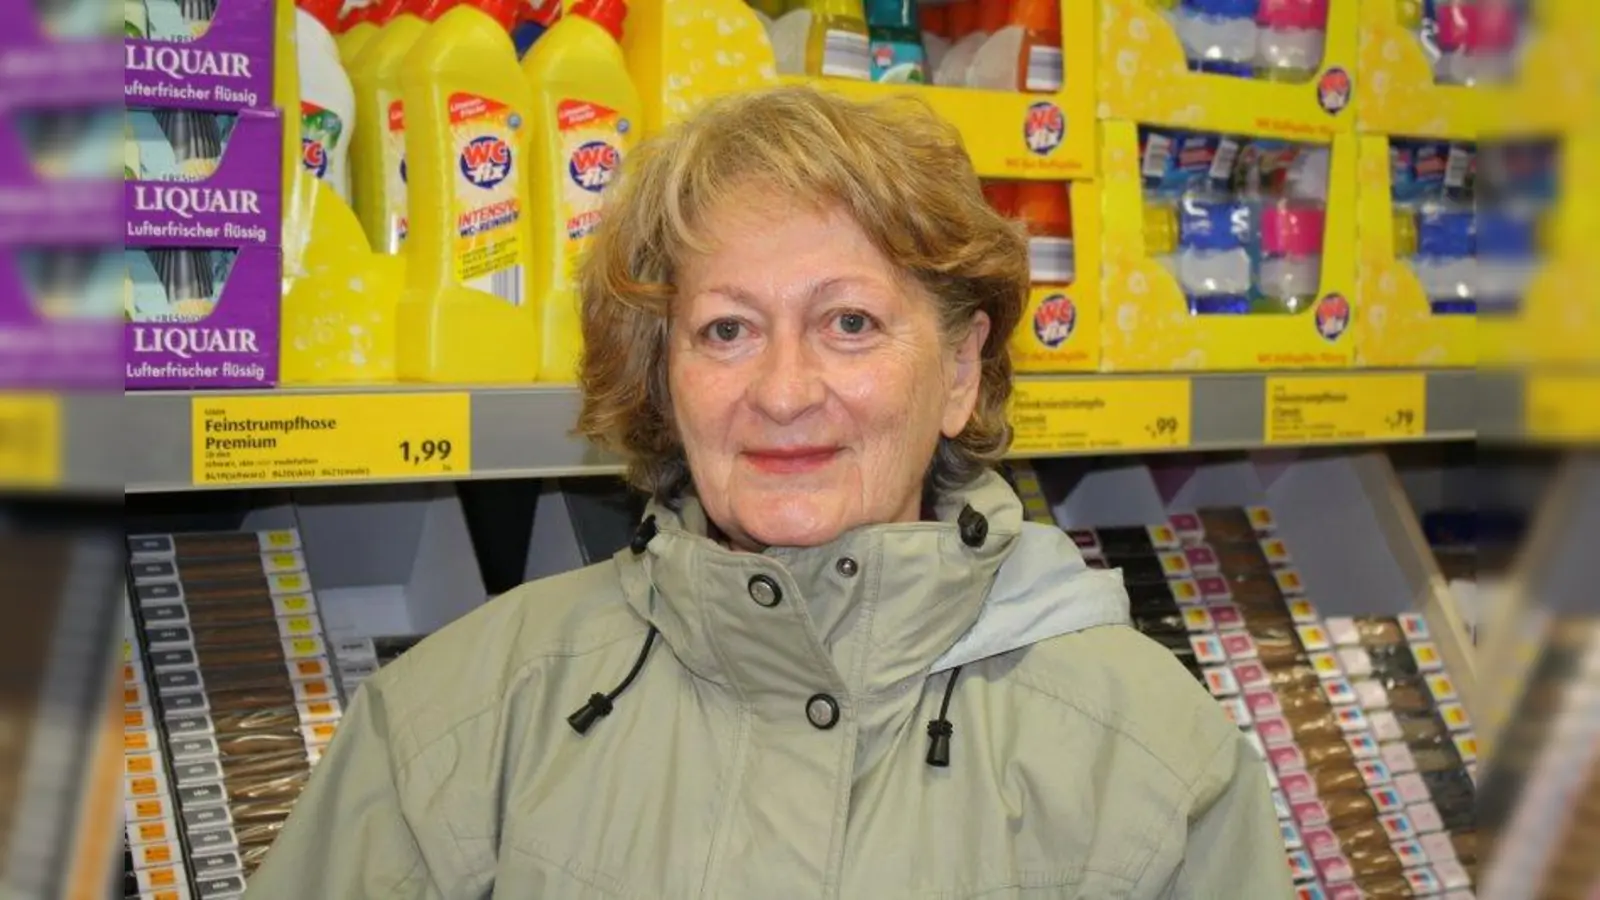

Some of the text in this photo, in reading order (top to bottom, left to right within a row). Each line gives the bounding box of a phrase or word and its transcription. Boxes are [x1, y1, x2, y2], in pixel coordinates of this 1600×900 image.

[124, 44, 252, 80] LIQUAIR
[124, 80, 258, 107] ufterfrischer flüssig
[463, 140, 508, 169] WC
[572, 146, 615, 175] WC
[467, 162, 506, 184] fix
[134, 186, 261, 218] LIQUAIR
[127, 220, 267, 243] Lufterfrischer flüssig
[133, 328, 260, 359] LIQUAIR
[126, 360, 265, 381] Lufterfrischer flüssig
[205, 415, 337, 434] Feinstrumpfhose
[205, 434, 277, 450] Premium
[398, 439, 453, 465] 1,99
